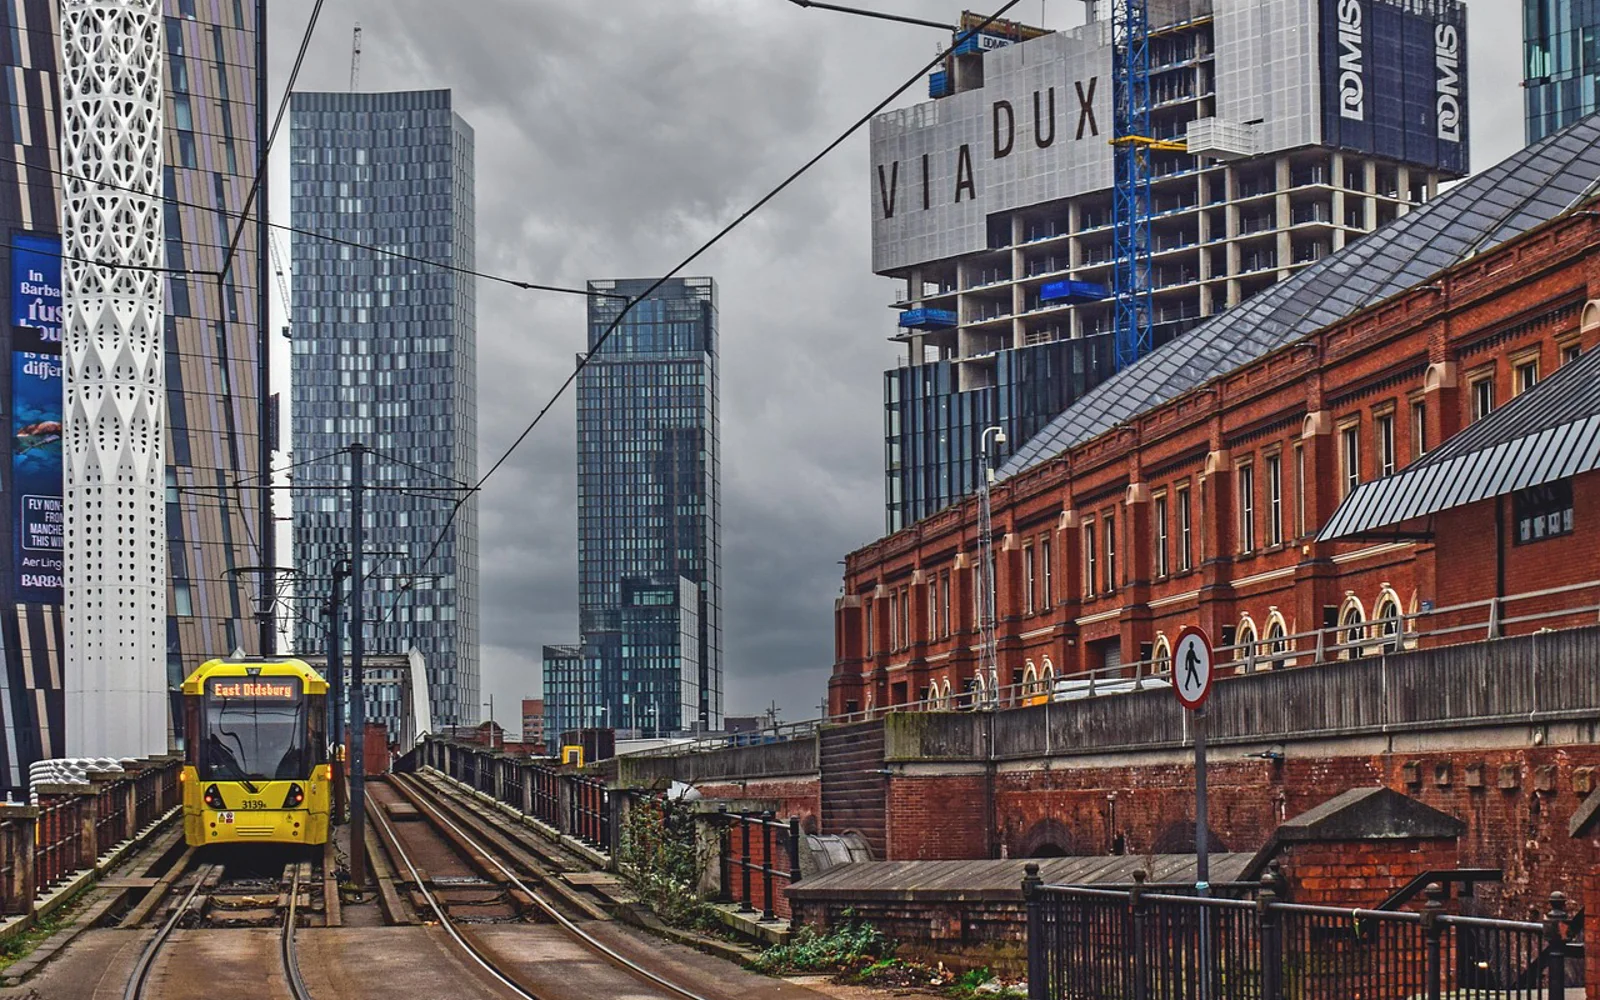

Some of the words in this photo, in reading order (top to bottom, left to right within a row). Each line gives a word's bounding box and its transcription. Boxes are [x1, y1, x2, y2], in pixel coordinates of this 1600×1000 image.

[1337, 0, 1364, 121] DOMIS
[1435, 24, 1460, 142] DOMIS
[878, 76, 1098, 219] VIADUX
[29, 269, 43, 282] In
[29, 499, 42, 510] FLY
[31, 534, 49, 547] THIS
[22, 557, 40, 567] Aer
[214, 683, 240, 696] East
[243, 683, 292, 698] Didsbury
